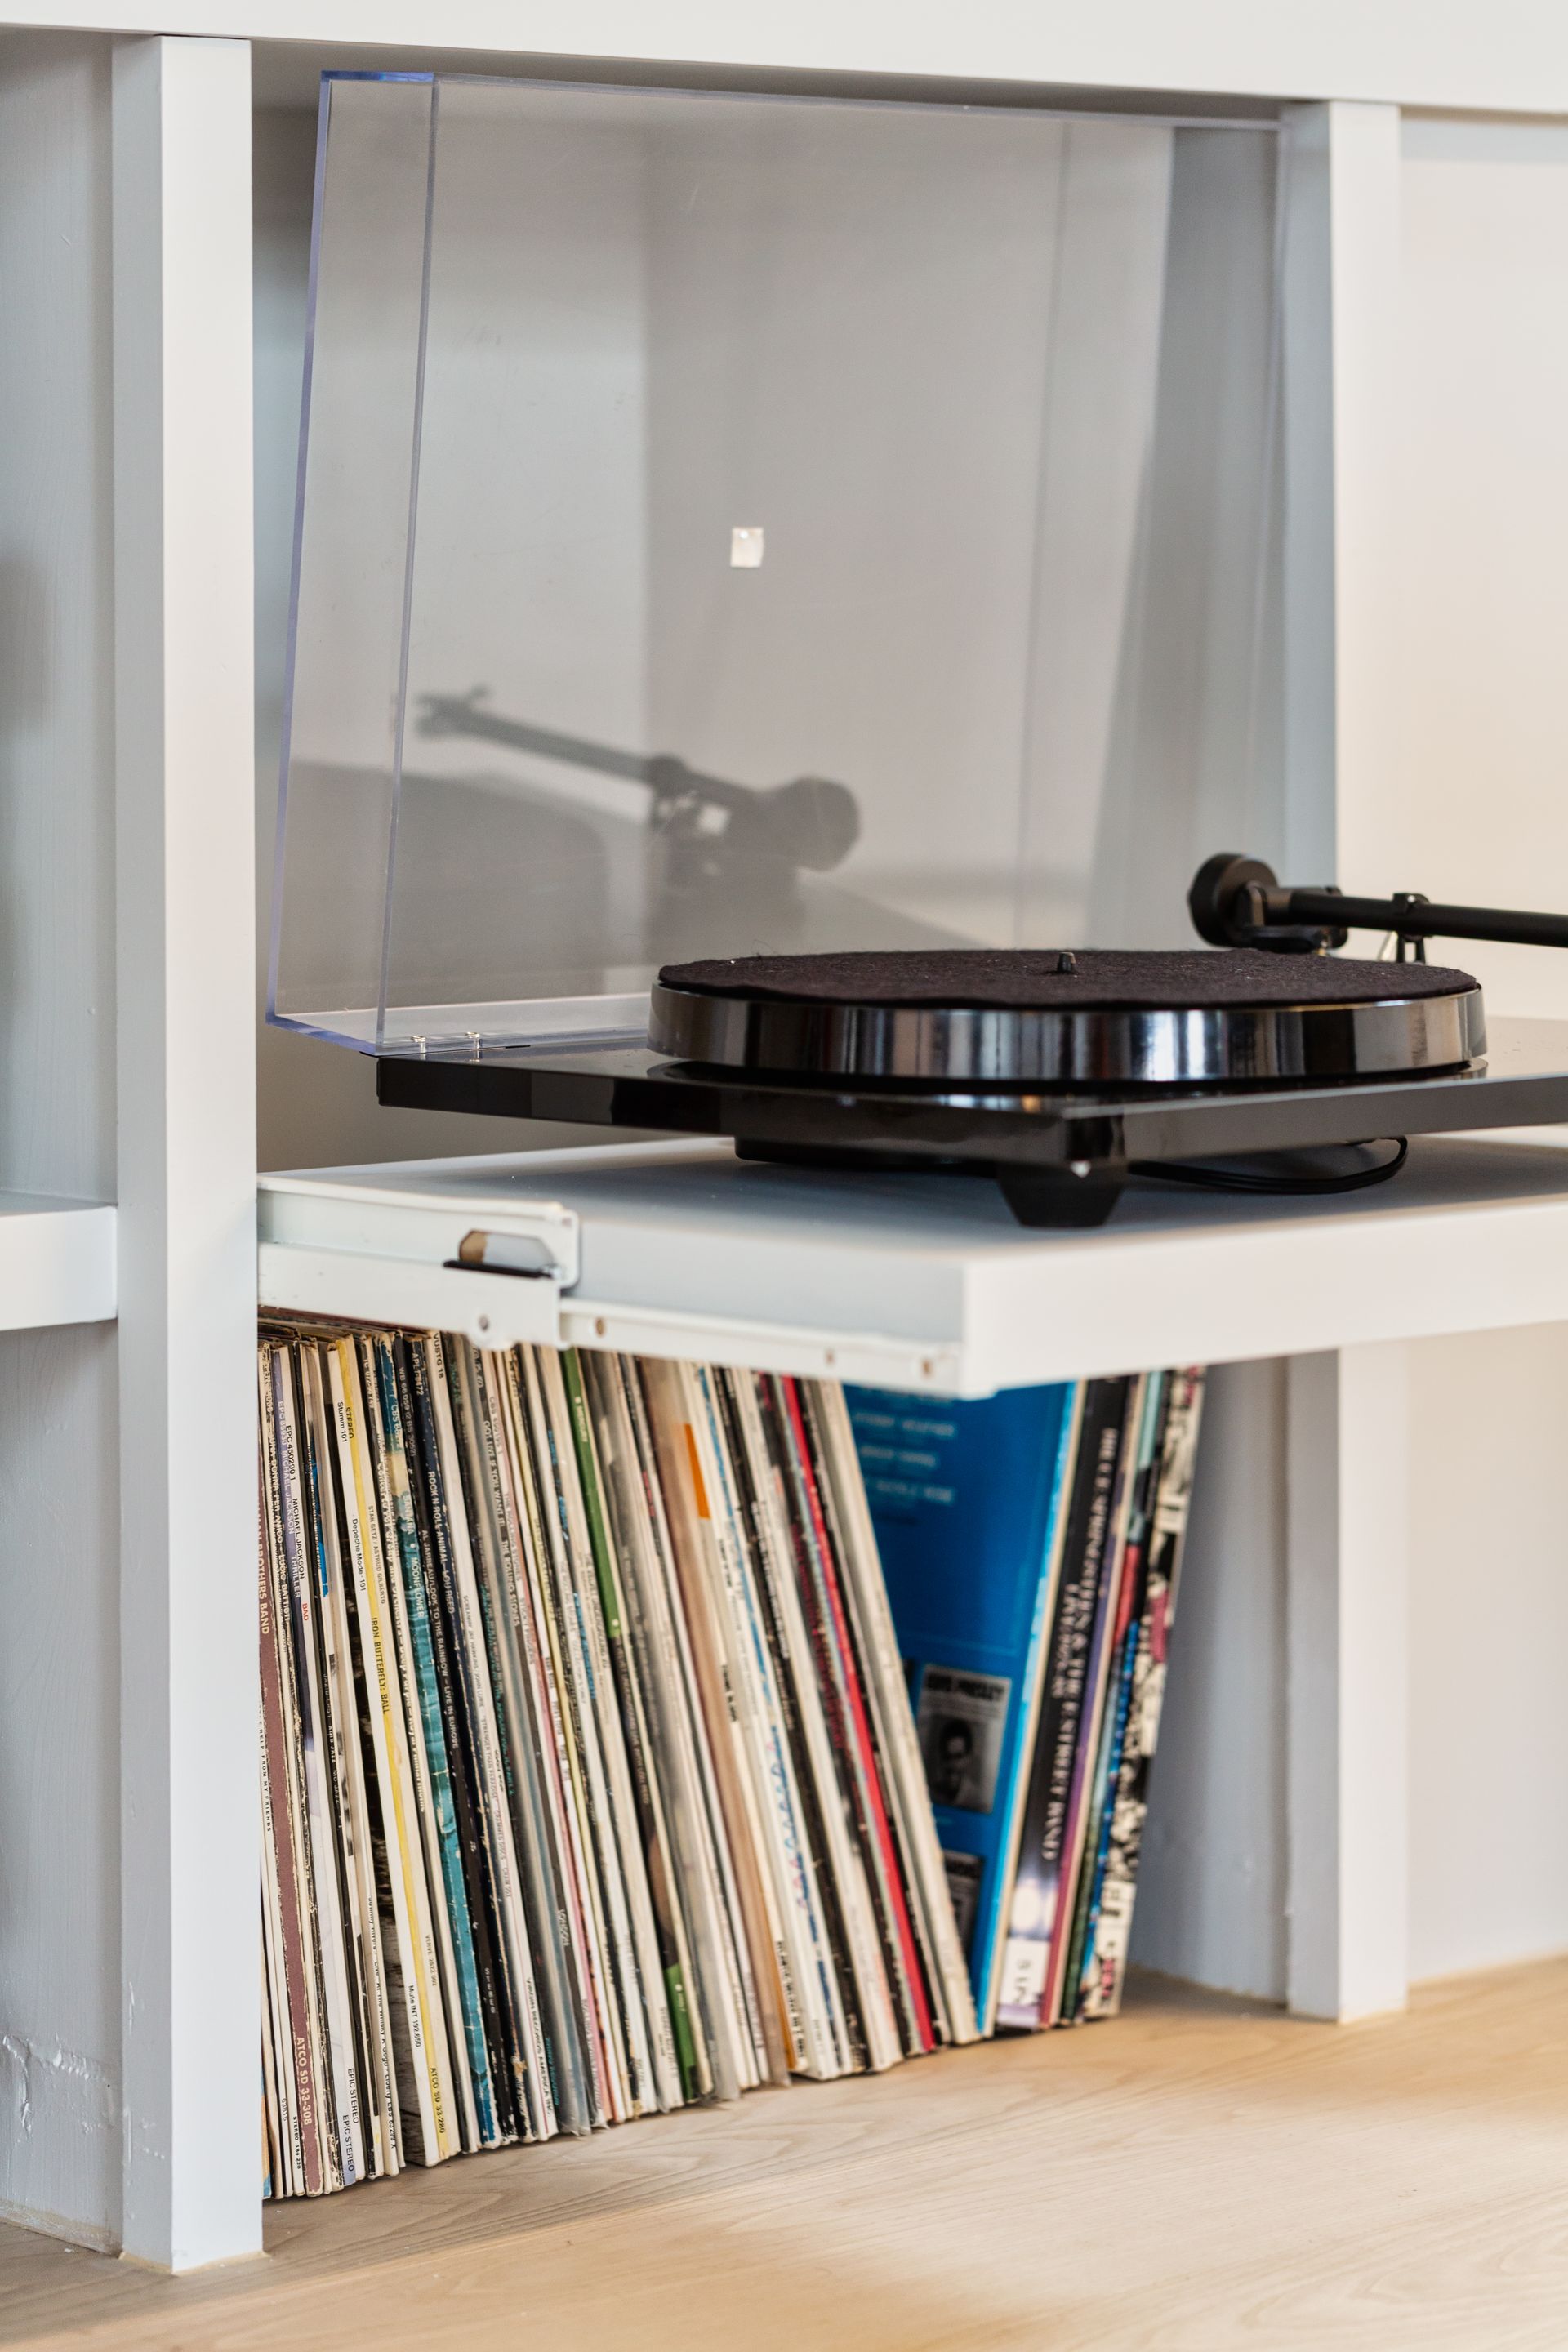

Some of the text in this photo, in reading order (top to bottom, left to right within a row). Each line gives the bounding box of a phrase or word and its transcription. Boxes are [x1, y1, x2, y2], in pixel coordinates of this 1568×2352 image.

[433, 1332, 444, 1379] VUSTG 18
[398, 1367, 405, 1380] WB
[401, 1383, 407, 1393] 66
[337, 1401, 345, 1428] Stumm
[345, 1406, 354, 1439] STEREO
[390, 1404, 399, 1422] CBS
[406, 1420, 413, 1432] BS
[483, 1419, 492, 1438] GOT
[268, 1437, 276, 1456] UNA
[270, 1459, 278, 1491] DONNA
[281, 1450, 290, 1486] MICHAEL
[428, 1471, 438, 1496] ROCK
[274, 1515, 283, 1543] AMICO
[285, 1492, 294, 1534] JACKSON
[292, 1498, 301, 1536] MICHAEL
[433, 1506, 443, 1529] ROLL
[351, 1518, 360, 1549] Depeche
[421, 1530, 428, 1540] AL
[436, 1530, 447, 1564] ANIMAL
[501, 1540, 510, 1555] THE
[278, 1553, 287, 1581] LUCIO
[296, 1539, 305, 1579] JACKSON
[373, 1546, 381, 1571] ASTRUD
[403, 1494, 425, 1618] SANTANA MOONFLOWER
[1070, 1496, 1109, 1628] SPRINGSTEEN
[255, 1544, 270, 1634] BROTHERS BAND
[291, 1555, 300, 1598] THRILLER
[376, 1572, 385, 1604] GILBERTO
[423, 1541, 439, 1605] JARREAU/LOOK
[504, 1556, 515, 1592] ROLLING
[281, 1584, 290, 1621] BATTISTI
[433, 1606, 439, 1619] TO
[445, 1589, 455, 1614] REED
[510, 1593, 520, 1626] STONES
[371, 1617, 390, 1714] IRON BUTTERFLY: BALL
[437, 1637, 448, 1676] RAINBOW
[1064, 1659, 1086, 1697] THE
[447, 1705, 453, 1714] IN
[449, 1716, 458, 1749] EUROPE
[1049, 1719, 1076, 1797] STREET
[264, 1780, 268, 1793] MY
[1041, 1801, 1067, 1860] BAND
[408, 1984, 416, 2004] Mute
[296, 2036, 312, 2126] ATCO SD 33-308
[350, 2088, 360, 2124] STEREO
[430, 2067, 446, 2134] ATCO SD 33-280
[341, 2114, 354, 2172] EPIC STEREO
